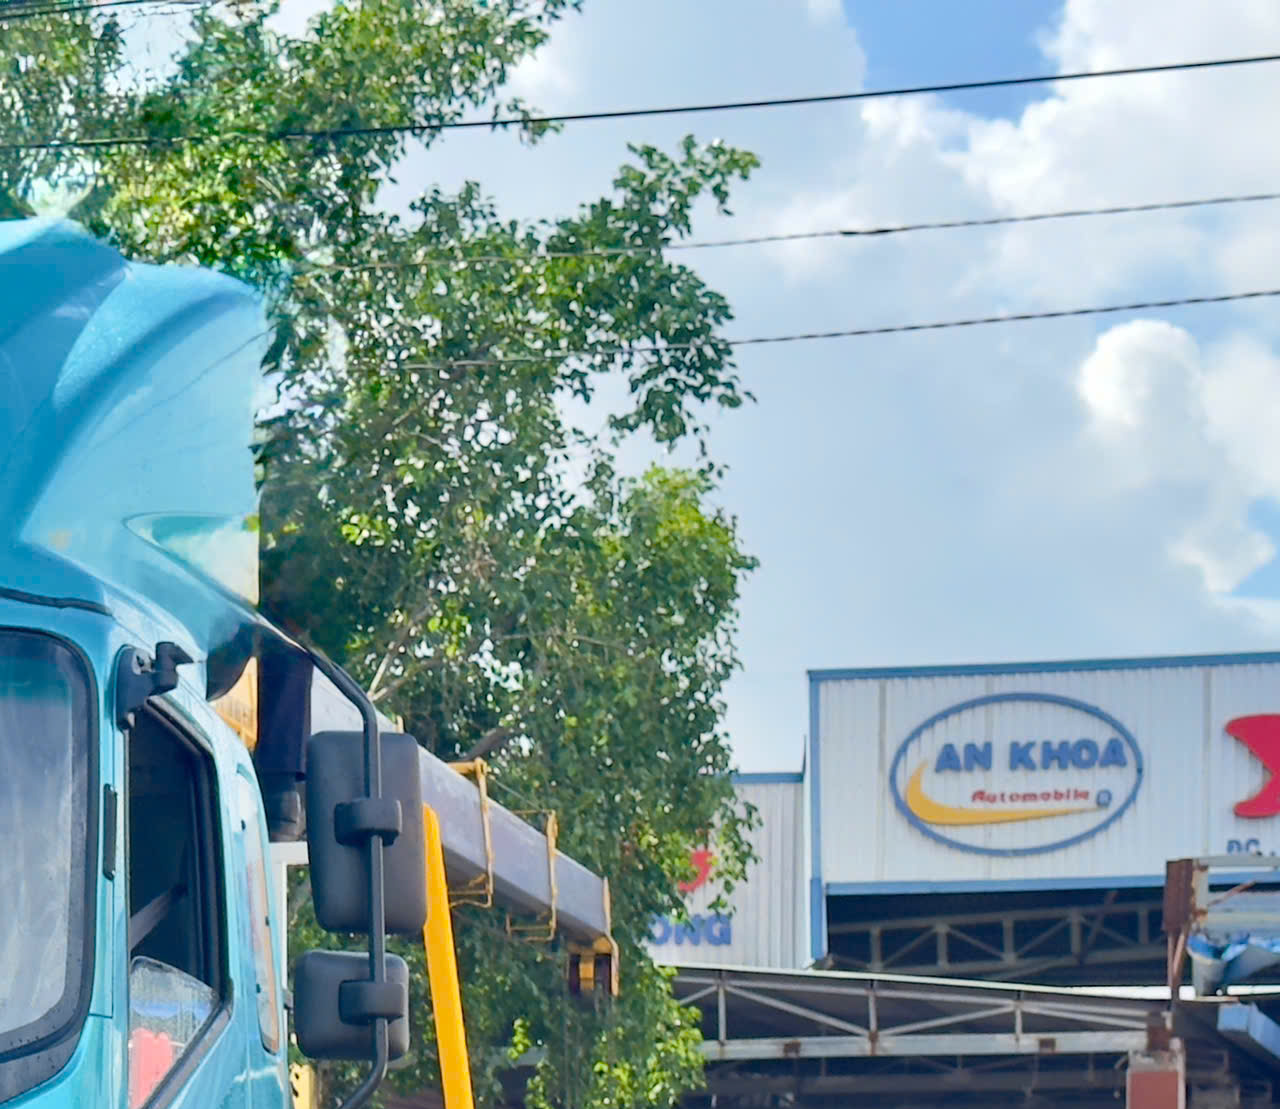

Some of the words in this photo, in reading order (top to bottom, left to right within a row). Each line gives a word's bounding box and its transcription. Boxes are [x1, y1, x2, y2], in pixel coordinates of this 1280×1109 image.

[935, 741, 993, 773] AN
[1008, 737, 1127, 771] KHOA
[972, 789, 1089, 803] Automobile
